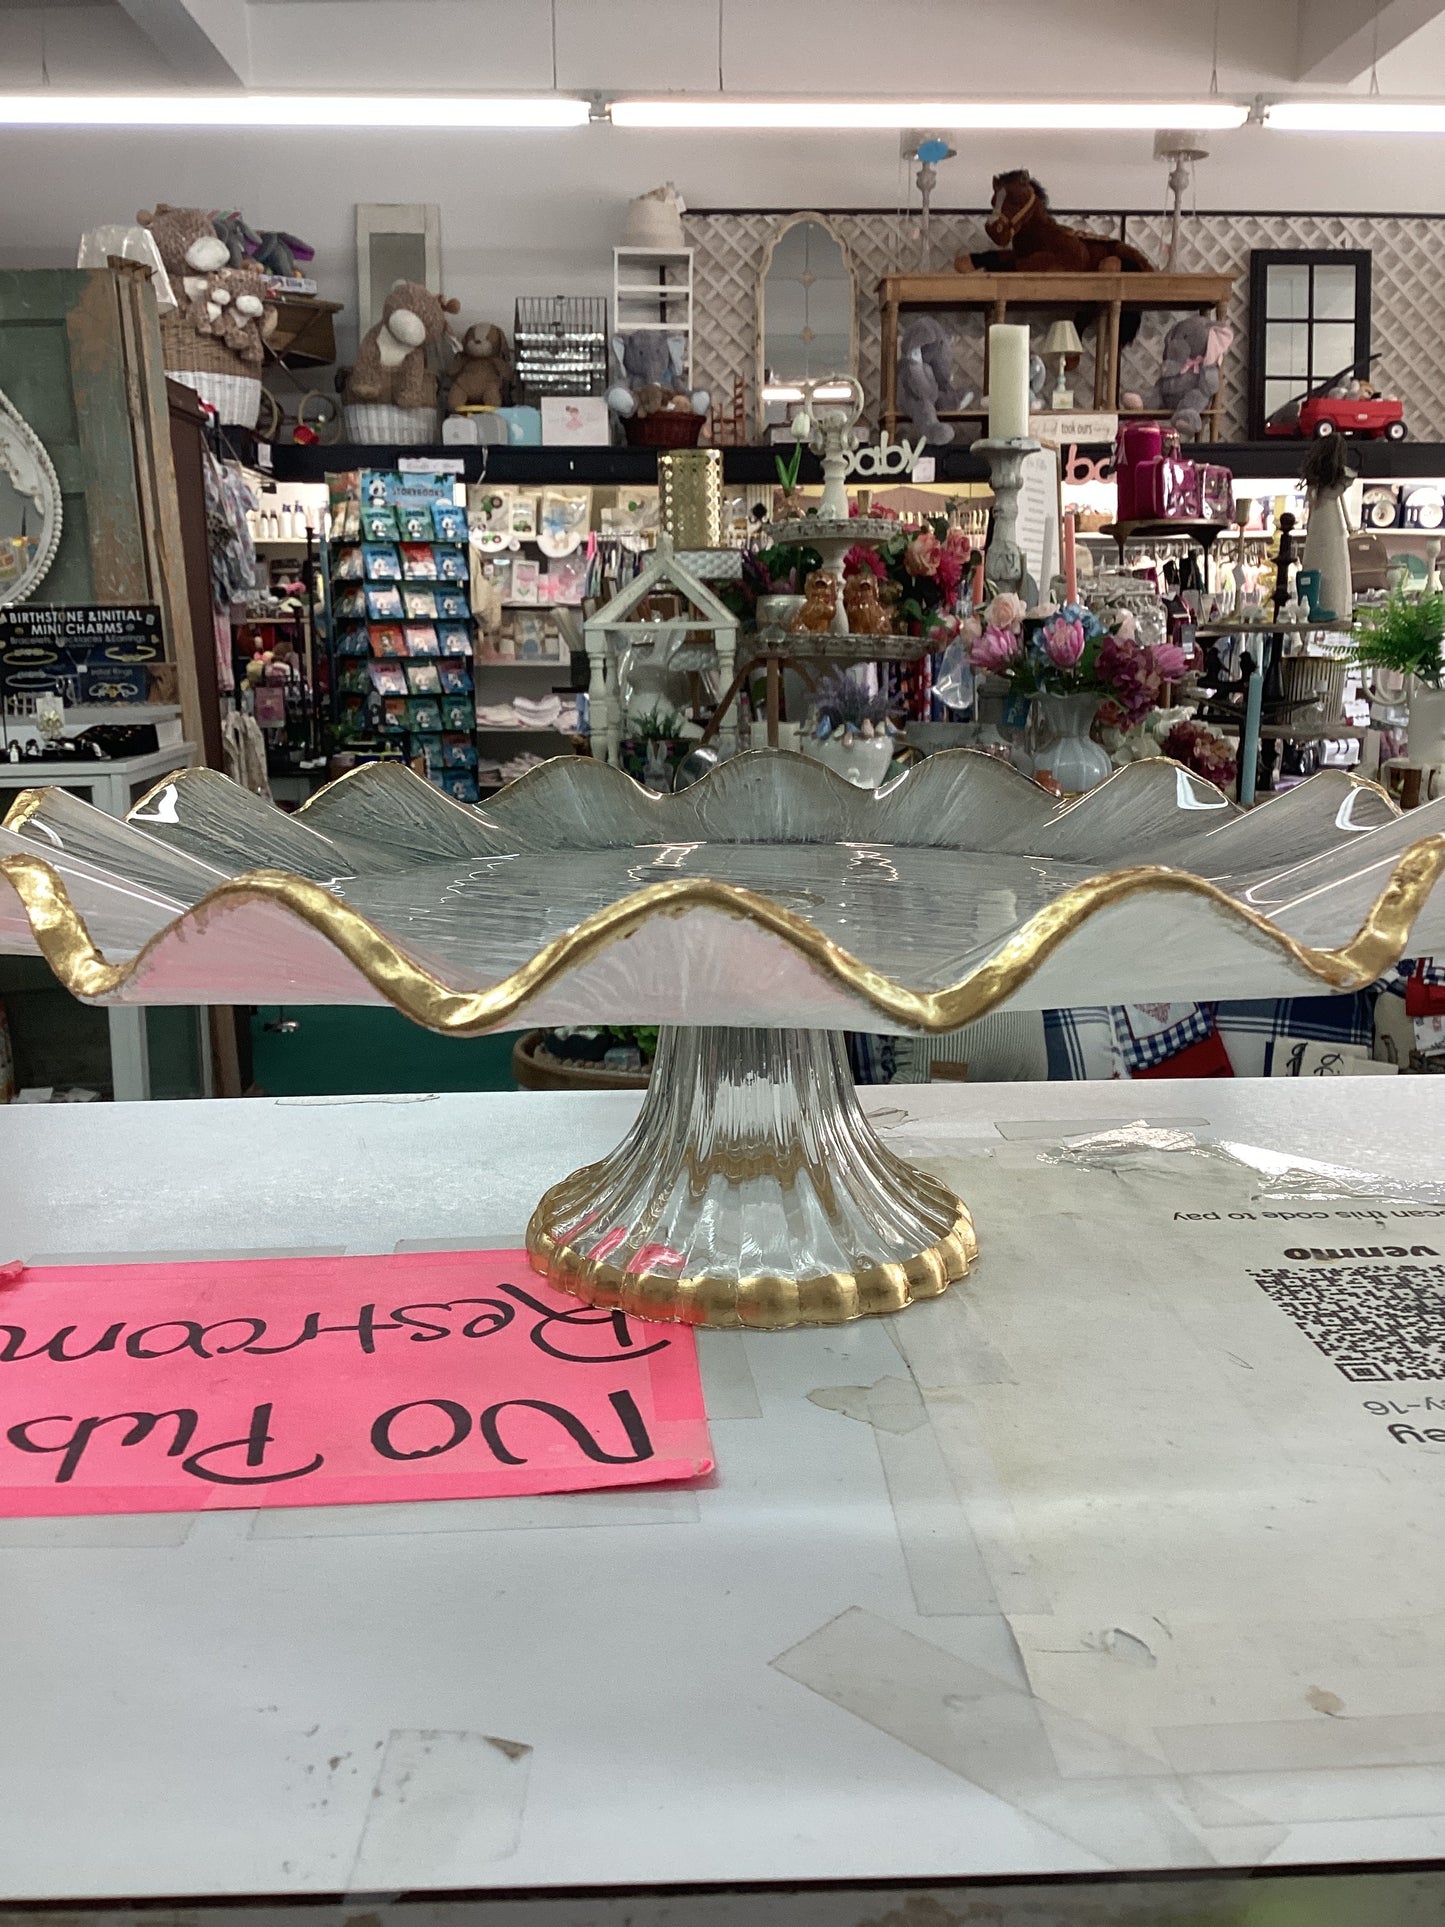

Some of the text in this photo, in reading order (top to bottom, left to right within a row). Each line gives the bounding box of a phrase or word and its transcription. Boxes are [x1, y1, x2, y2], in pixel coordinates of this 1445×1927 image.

[1061, 421, 1075, 434] took
[1077, 423, 1092, 434] ours
[392, 487, 445, 497] STORYBOOKS
[9, 611, 84, 624] BIRTHSTONE
[31, 622, 123, 635] MINI CHARMS
[1173, 1211, 1221, 1221] pay
[1228, 1212, 1257, 1220] to
[1262, 1211, 1329, 1220] code
[1336, 1210, 1388, 1219] this
[1284, 1245, 1440, 1260] venmo
